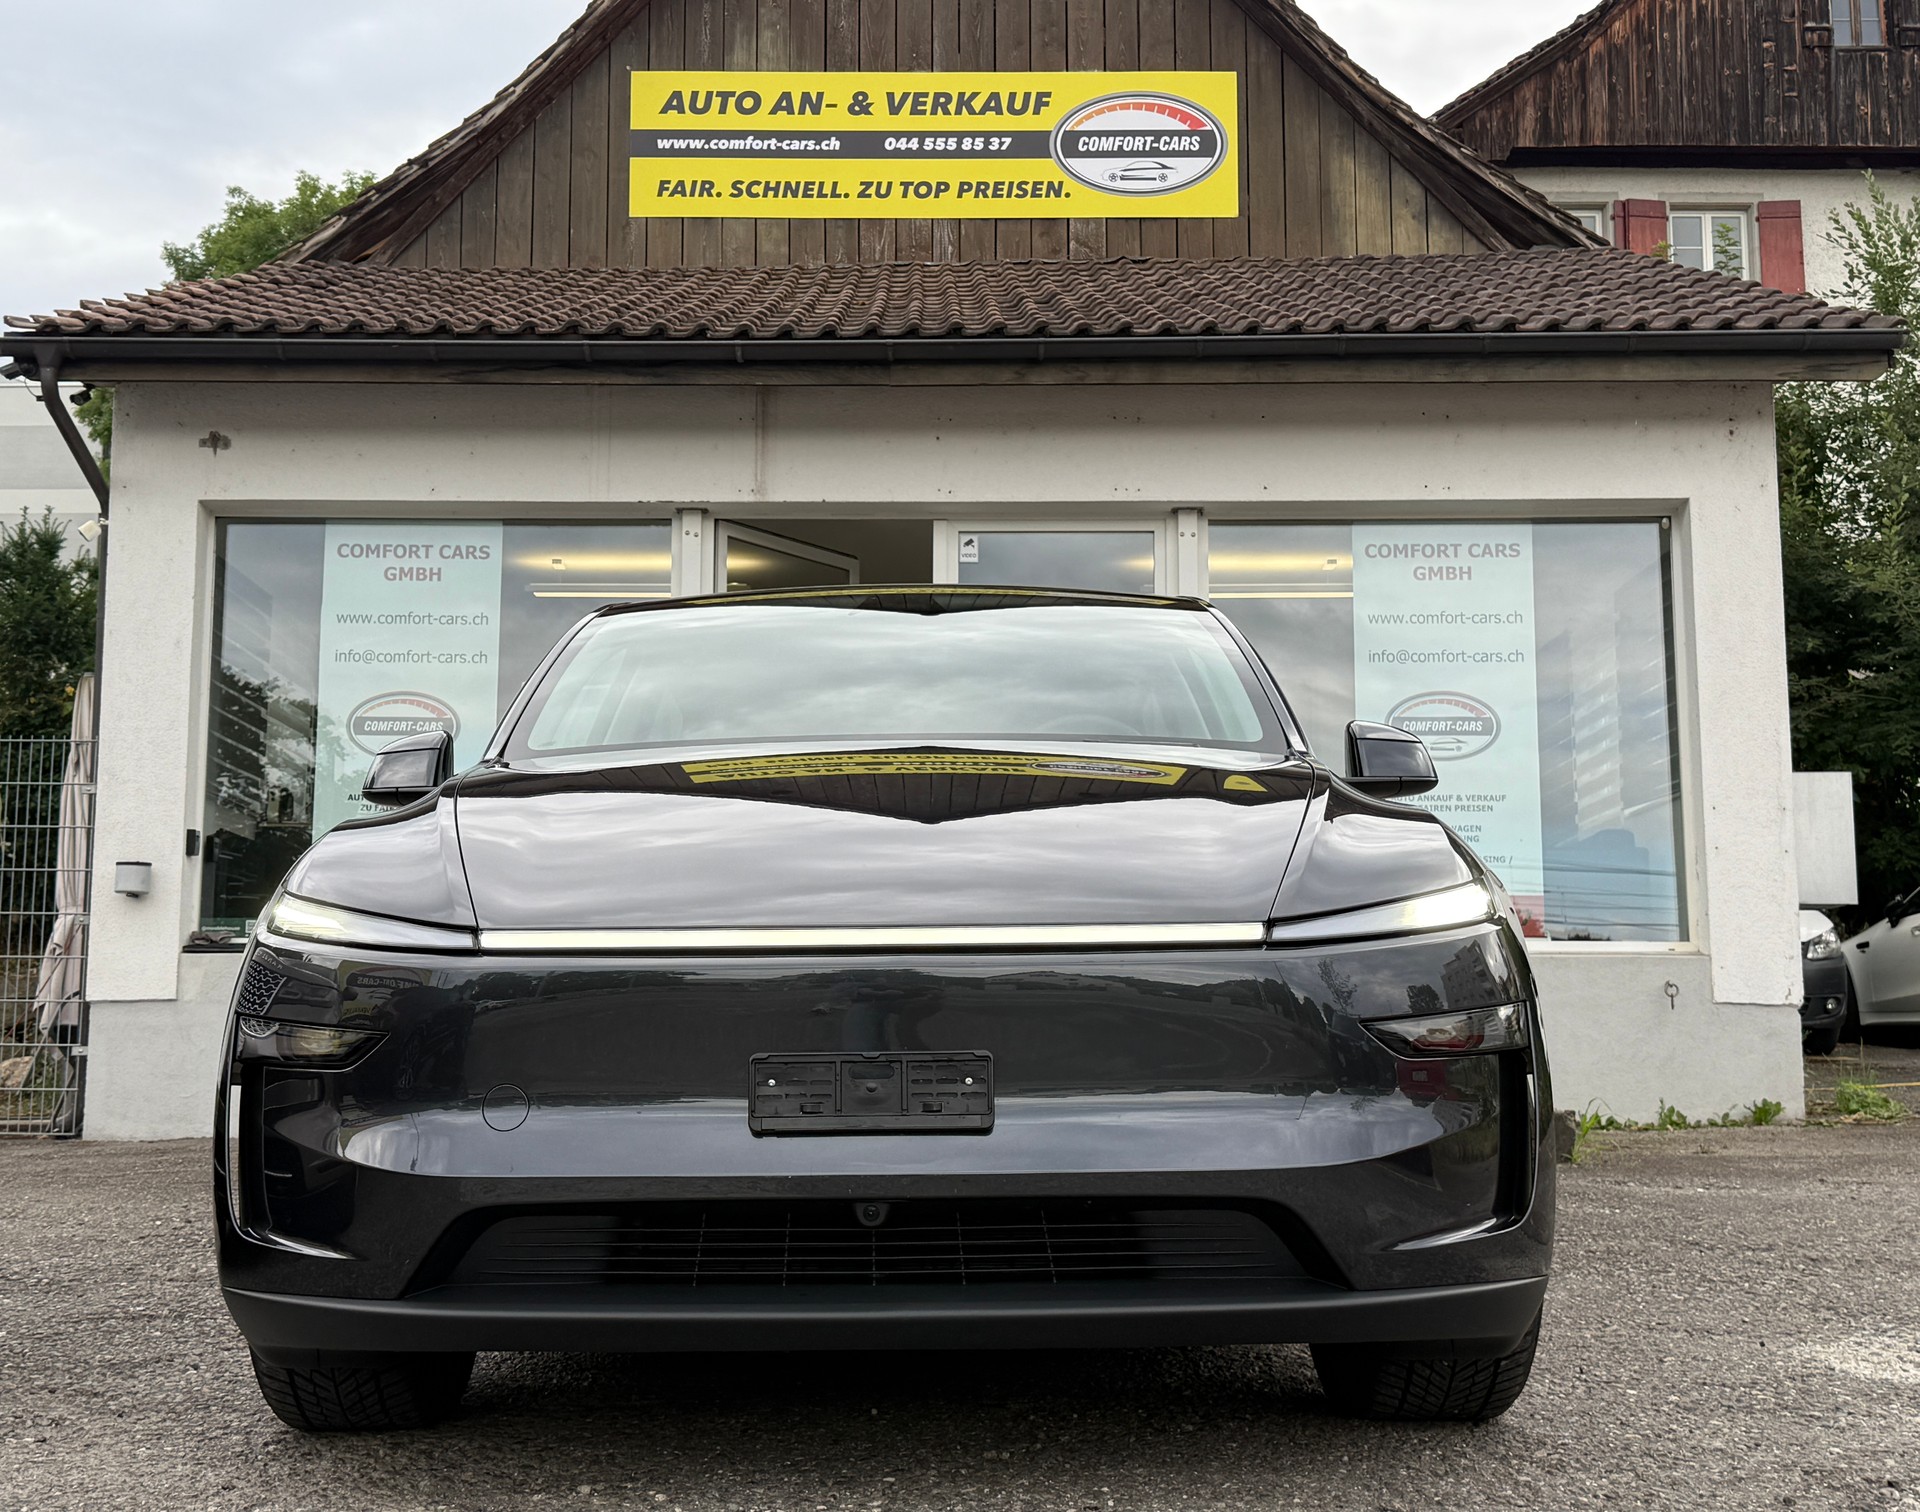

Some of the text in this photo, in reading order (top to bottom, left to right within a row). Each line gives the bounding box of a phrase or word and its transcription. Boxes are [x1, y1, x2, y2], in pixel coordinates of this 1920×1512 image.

[659, 90, 1052, 116] AUTO AN- & VERKAUF
[657, 136, 841, 151] www.comfort-cars.ch
[884, 137, 1012, 150] 044 555 85 37
[1078, 136, 1201, 151] COMFORT-CARS
[657, 180, 1071, 199] FAIR. SCHNELL. ZU TOP PREISEN.
[337, 543, 490, 560] COMFORT CARS
[1364, 543, 1521, 558] COMFORT CARS
[384, 567, 442, 582] GMBH
[1413, 566, 1472, 581] GMBH
[336, 611, 489, 625] www.comfort-cars.ch
[1368, 611, 1523, 624] www.comfort-cars.ch
[335, 649, 488, 664] info@comfort-cars.ch
[1368, 650, 1525, 664] info@comfort-cars.ch
[364, 720, 444, 731] COMFORT-CARS
[1402, 720, 1483, 732] COMFORT-CARS
[1417, 794, 1453, 802] ANKAUF
[1456, 794, 1463, 802] &
[1465, 794, 1507, 802] VERKAUF
[1422, 804, 1494, 812] AIREN PREISEN
